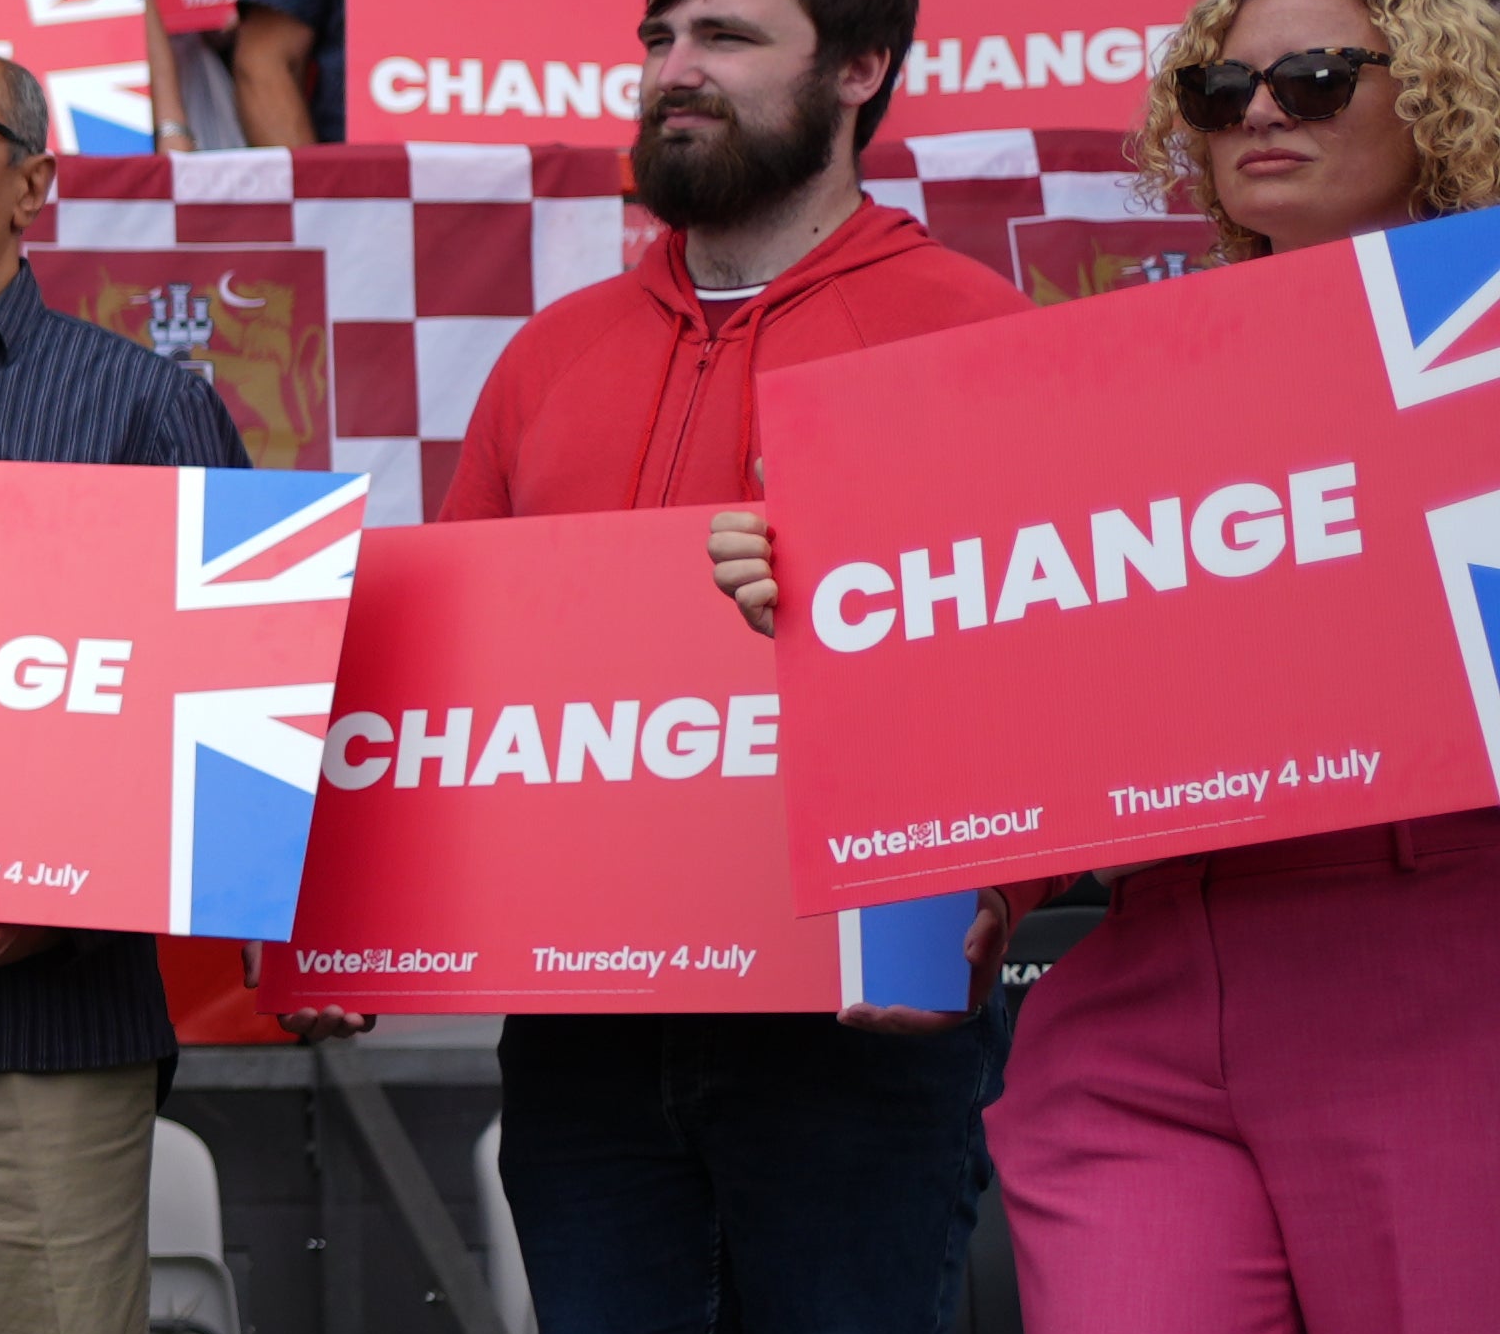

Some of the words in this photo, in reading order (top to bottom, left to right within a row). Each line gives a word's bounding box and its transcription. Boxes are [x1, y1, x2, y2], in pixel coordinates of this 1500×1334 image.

[369, 56, 639, 120] CHANG
[811, 461, 1363, 653] CHANGE
[320, 693, 780, 790] CHANGE
[828, 831, 906, 864] Vote
[934, 807, 1044, 848] Labour
[1108, 769, 1270, 816] Thursday
[1278, 759, 1301, 787] 4
[1307, 749, 1381, 785] July
[3, 860, 23, 884] 4
[27, 863, 90, 895] July
[296, 949, 360, 974] Vote
[385, 948, 479, 973] Labour
[532, 945, 666, 979] Thursday
[669, 945, 690, 970] 4
[694, 944, 757, 978] July
[1002, 964, 1054, 985] KA
